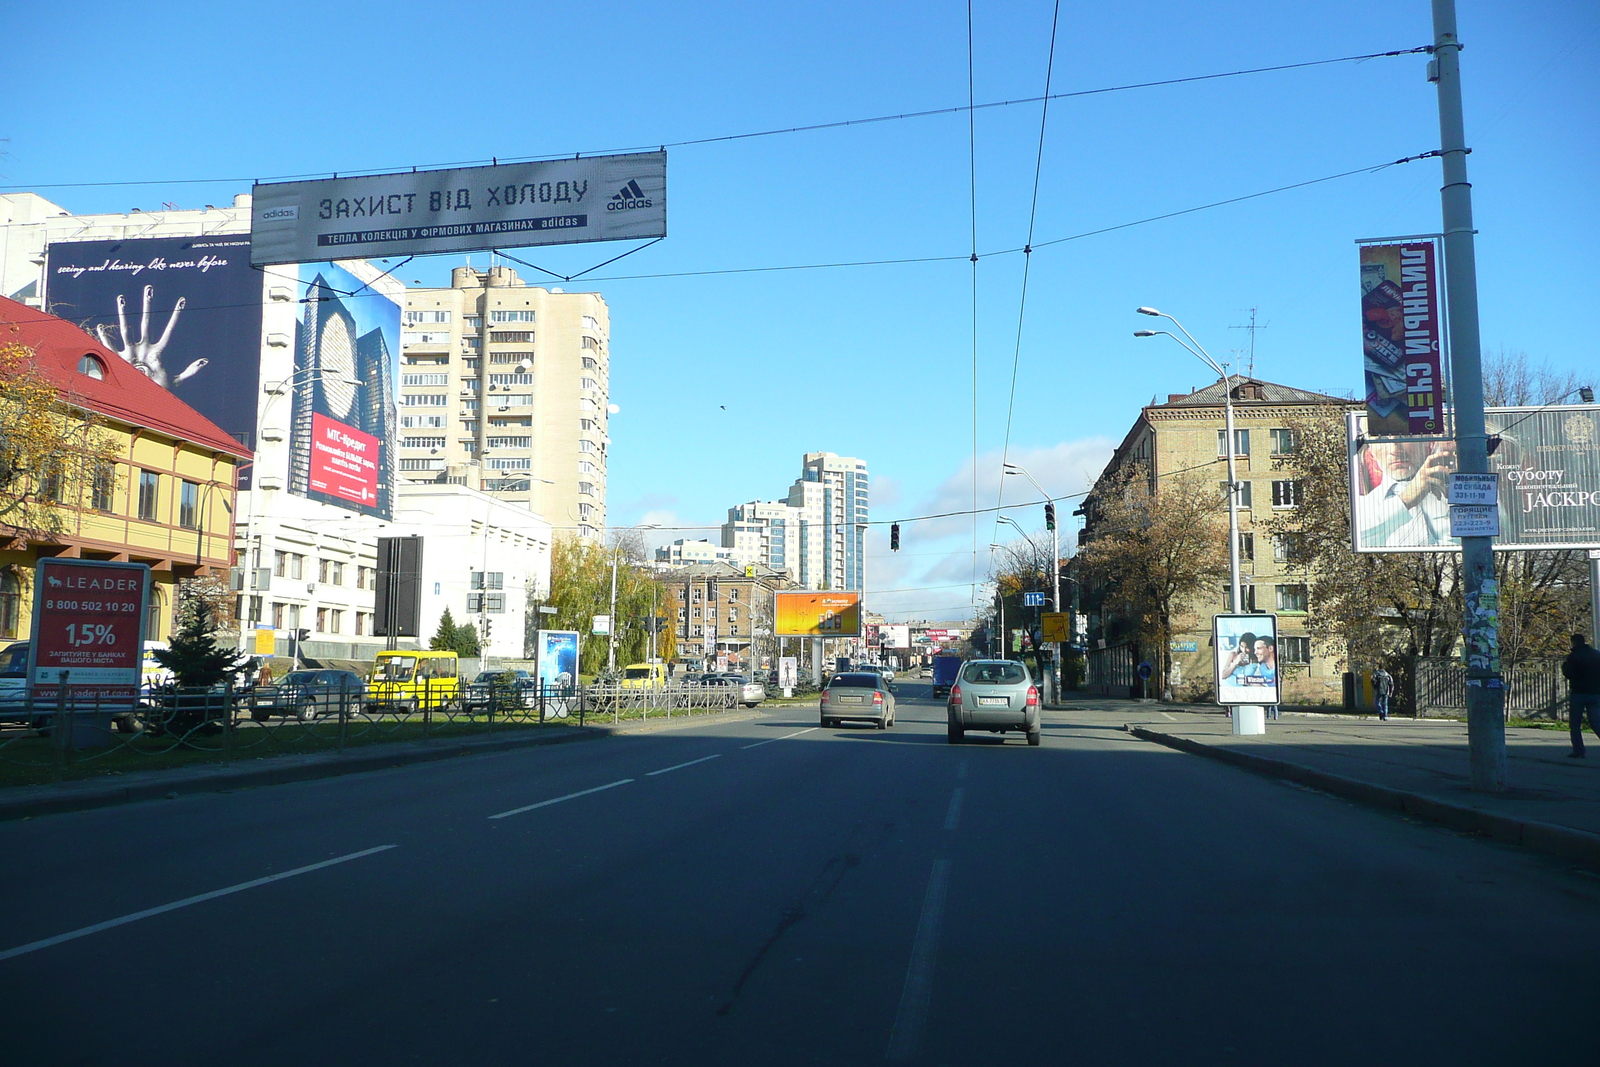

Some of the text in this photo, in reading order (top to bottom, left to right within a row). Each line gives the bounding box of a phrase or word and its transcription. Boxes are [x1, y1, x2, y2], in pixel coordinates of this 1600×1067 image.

[319, 179, 589, 220] ЗАХИСТ ВІД ХОЛОДУ
[606, 197, 652, 212] adidas
[263, 207, 295, 219] adidas
[328, 216, 578, 244] ТЕПЛА КОЛЕКЦІЯ У ФІРМОВИХ МАГАЗИНАХ adidas
[58, 255, 228, 278] seeing and hearing like never before
[1401, 247, 1438, 421] ЛИЧНЫЙ СЧЕТ
[327, 427, 366, 452] МТС-Кредит
[1507, 466, 1564, 485] суботу
[67, 577, 137, 591] LEADER
[46, 600, 135, 612] 8 800 502 10 20
[65, 623, 116, 647] 1,5%
[49, 650, 91, 658] ЗАПИТУЙТЕ
[40, 689, 130, 697] ww.ladermt.com
